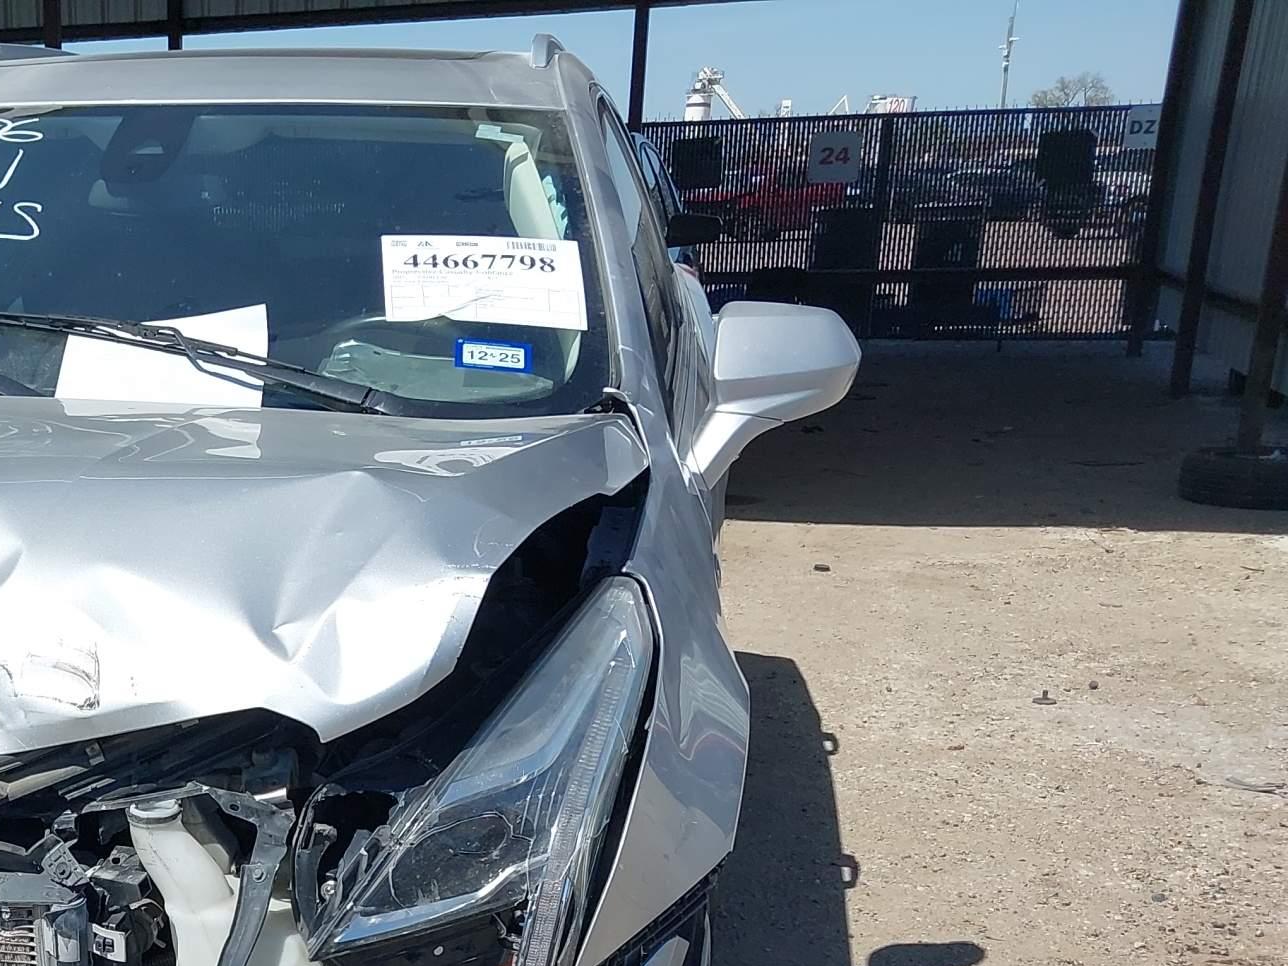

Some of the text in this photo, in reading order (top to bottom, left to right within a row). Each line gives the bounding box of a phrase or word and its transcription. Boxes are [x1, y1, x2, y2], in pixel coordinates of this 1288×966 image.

[1129, 119, 1157, 135] DZ
[818, 146, 851, 165] 24
[403, 253, 556, 274] 44667798
[467, 350, 521, 364] 12 25
